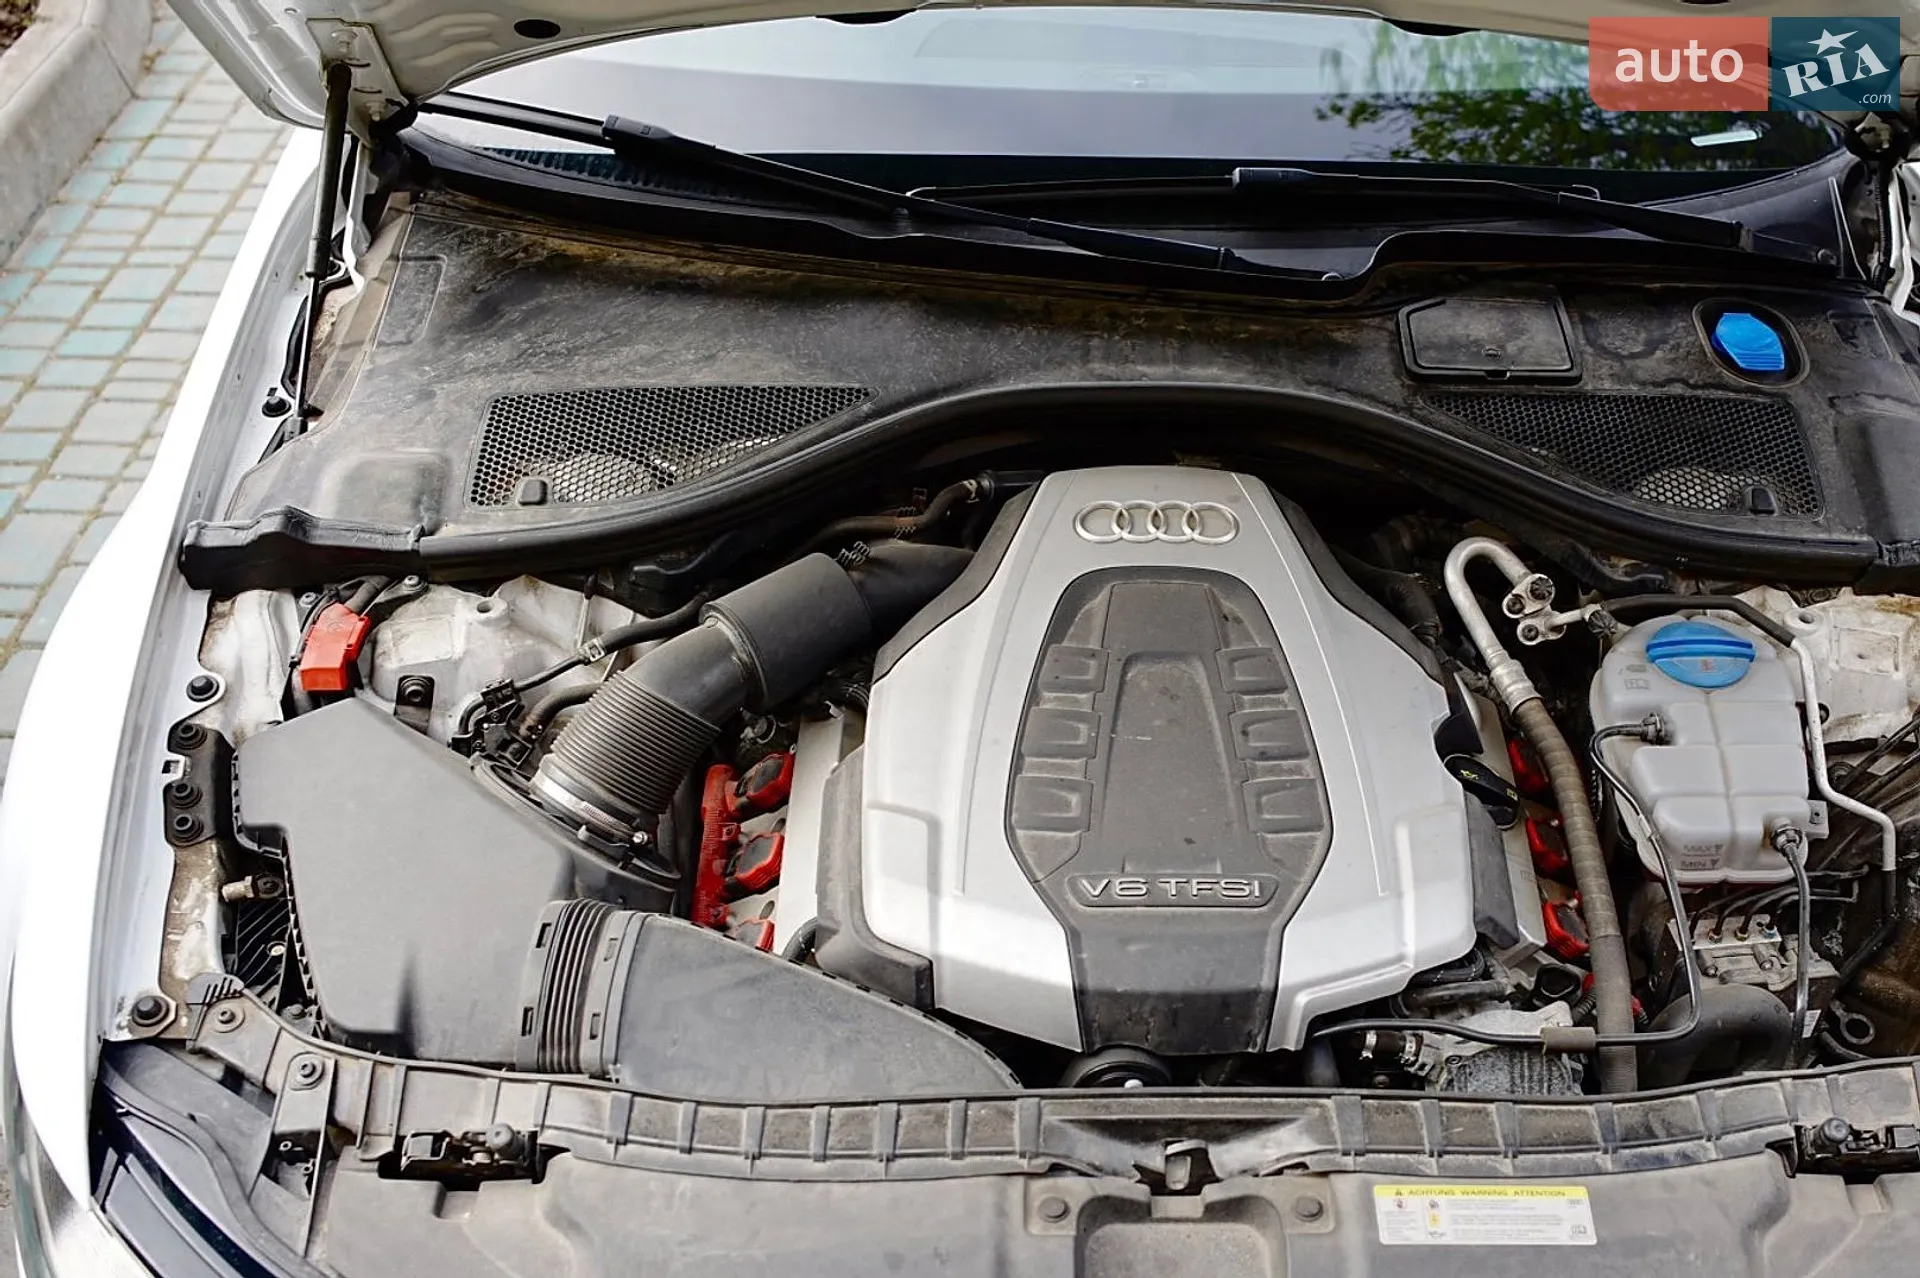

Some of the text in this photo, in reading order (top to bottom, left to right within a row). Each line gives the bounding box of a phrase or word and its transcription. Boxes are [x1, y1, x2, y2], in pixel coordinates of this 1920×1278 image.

[1081, 877, 1261, 899] V6 TFSI
[1408, 1189, 1456, 1197] ACHTUNG
[1460, 1189, 1508, 1197] WARNING
